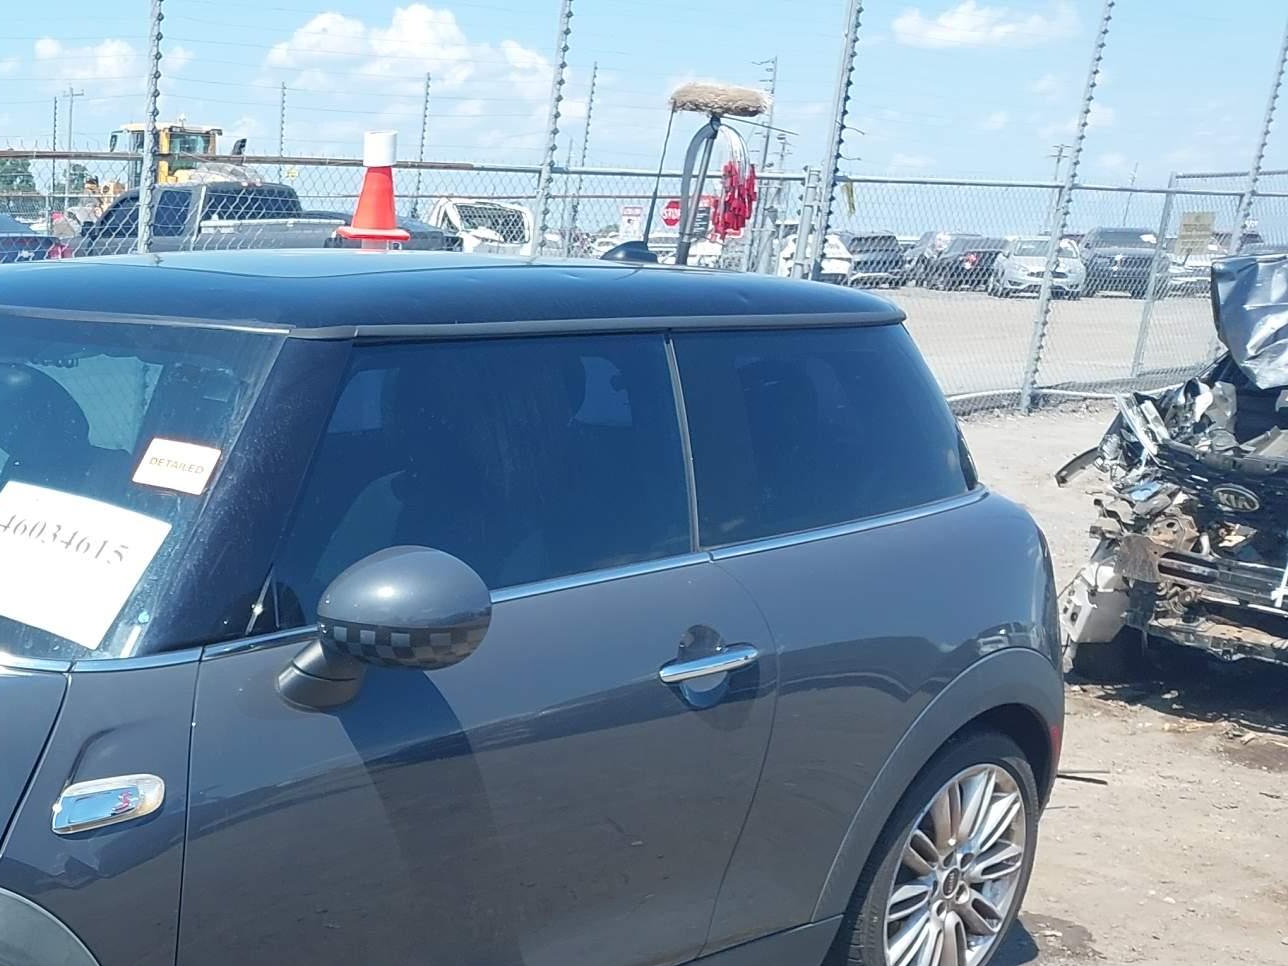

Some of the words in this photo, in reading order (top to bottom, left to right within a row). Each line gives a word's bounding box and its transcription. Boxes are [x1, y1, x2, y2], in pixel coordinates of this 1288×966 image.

[662, 207, 681, 219] STO
[149, 456, 205, 474] DETAILED
[1217, 491, 1253, 510] KIA
